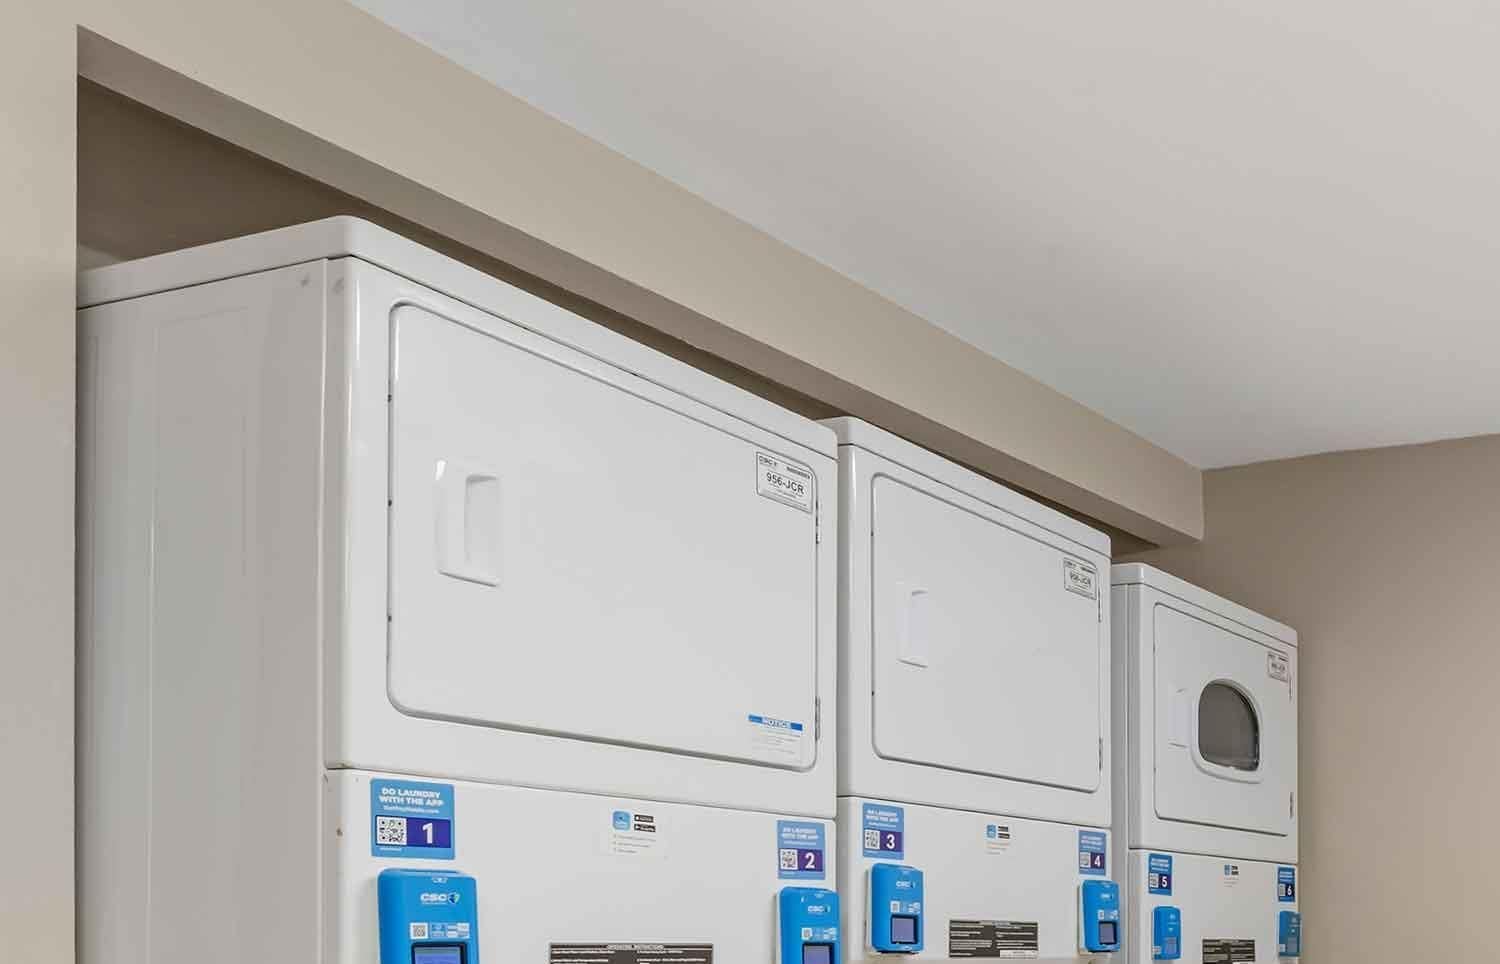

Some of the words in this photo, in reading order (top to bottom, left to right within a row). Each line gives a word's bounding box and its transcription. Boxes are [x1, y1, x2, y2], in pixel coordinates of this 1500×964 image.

[766, 471, 805, 495] 956-JCR
[382, 787, 397, 795] DO
[398, 789, 441, 799] LAUNDRY
[379, 795, 404, 804] WITH
[404, 797, 424, 805] THE
[425, 798, 445, 807] APP
[422, 822, 434, 844] 1
[886, 834, 896, 850] 3
[804, 851, 816, 869] 2
[1094, 855, 1102, 868] 4
[1161, 876, 1168, 888] 5
